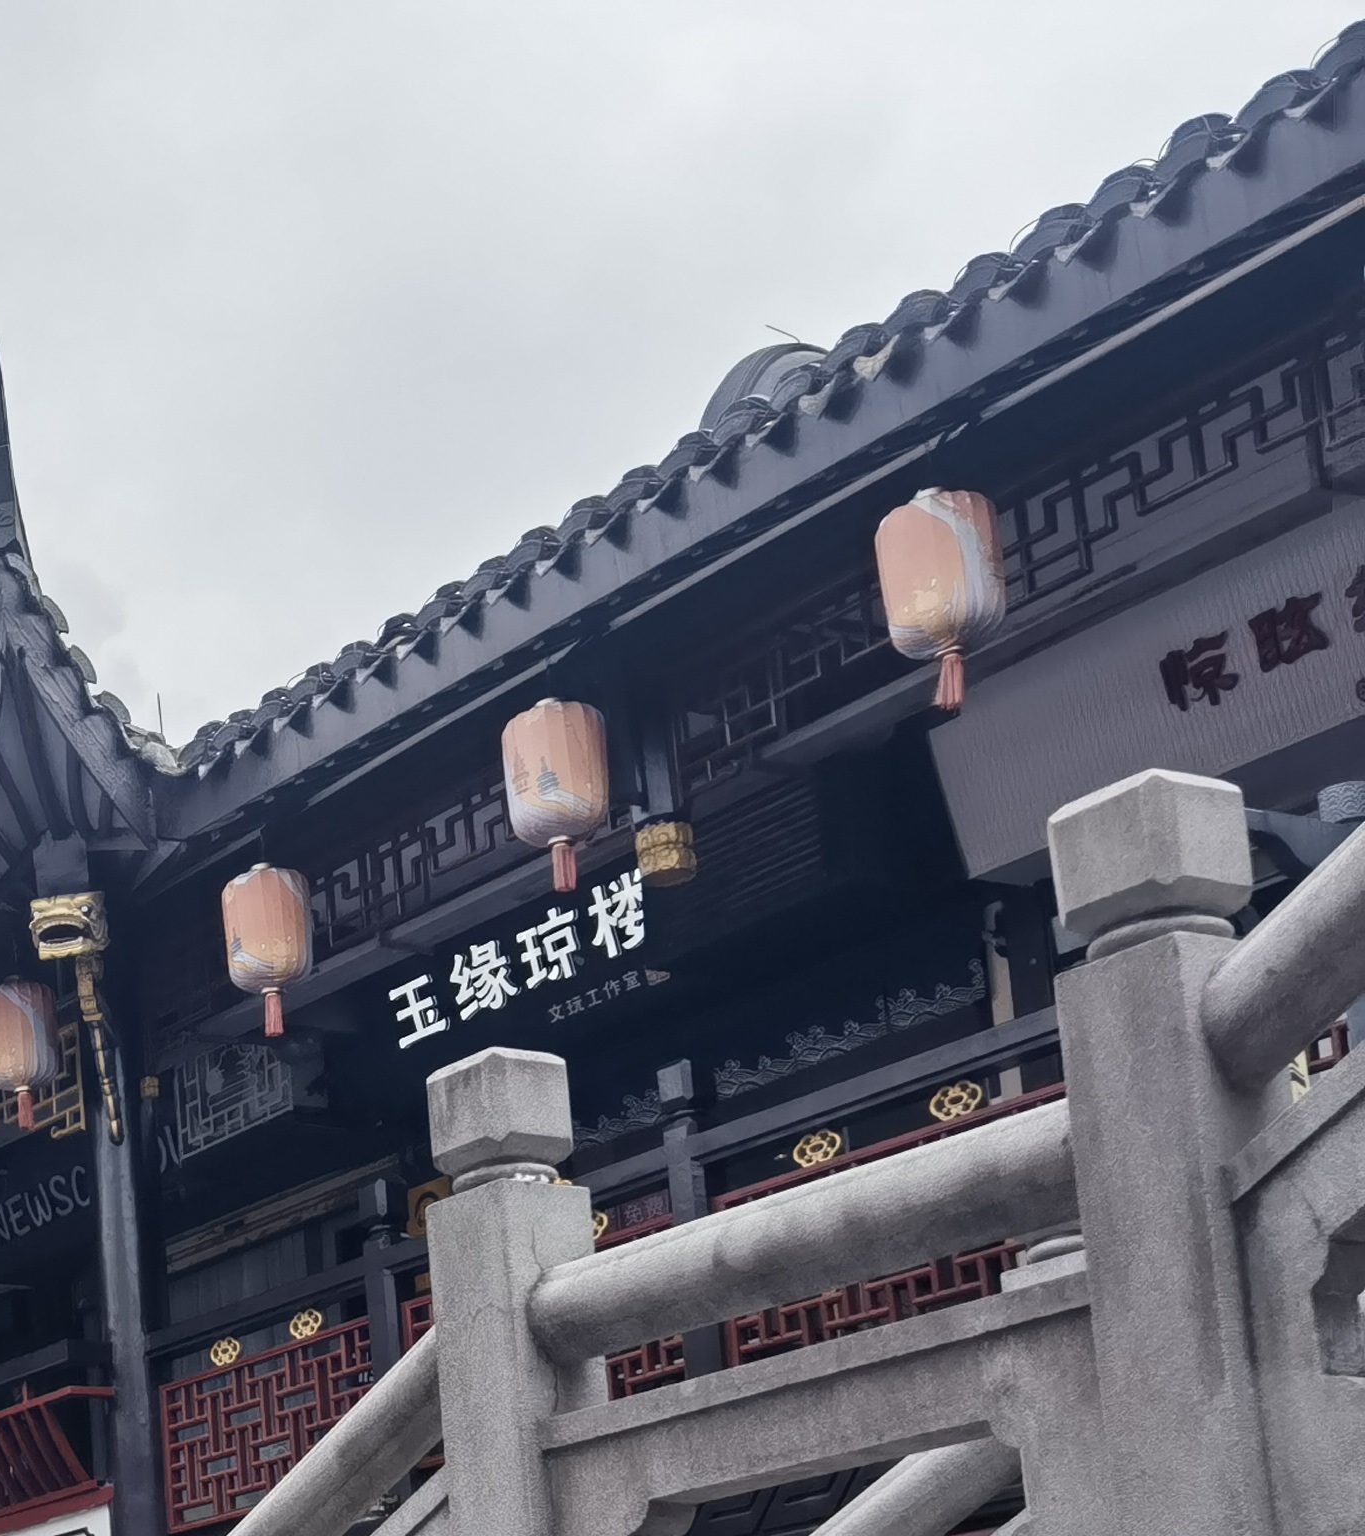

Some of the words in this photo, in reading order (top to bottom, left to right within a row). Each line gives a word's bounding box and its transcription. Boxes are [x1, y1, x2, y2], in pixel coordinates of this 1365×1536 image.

[389, 868, 646, 1049] 玉缘琼楼
[548, 970, 641, 1023] 文玩工作室
